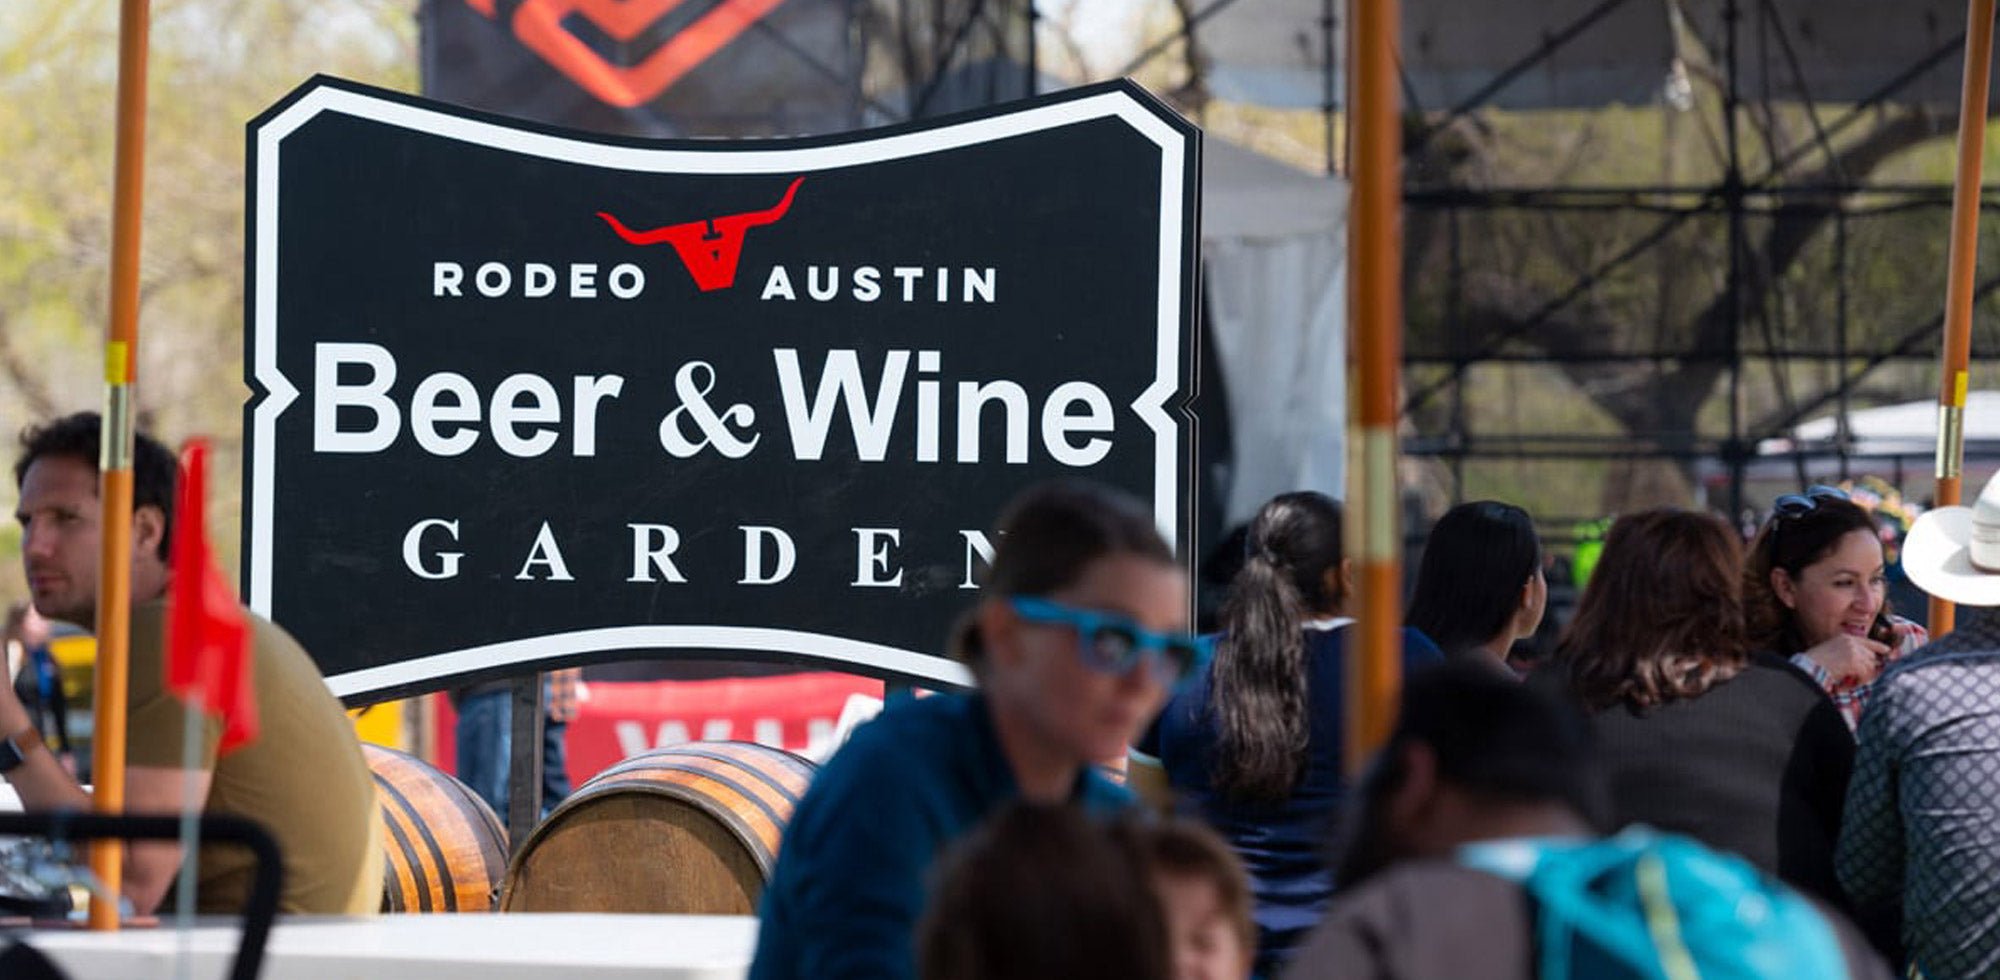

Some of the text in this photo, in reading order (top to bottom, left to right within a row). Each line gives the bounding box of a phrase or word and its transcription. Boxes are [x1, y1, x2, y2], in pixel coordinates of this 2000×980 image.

[434, 262, 996, 303] RODEO AUSTIN
[313, 341, 1115, 466] Beer & Wine
